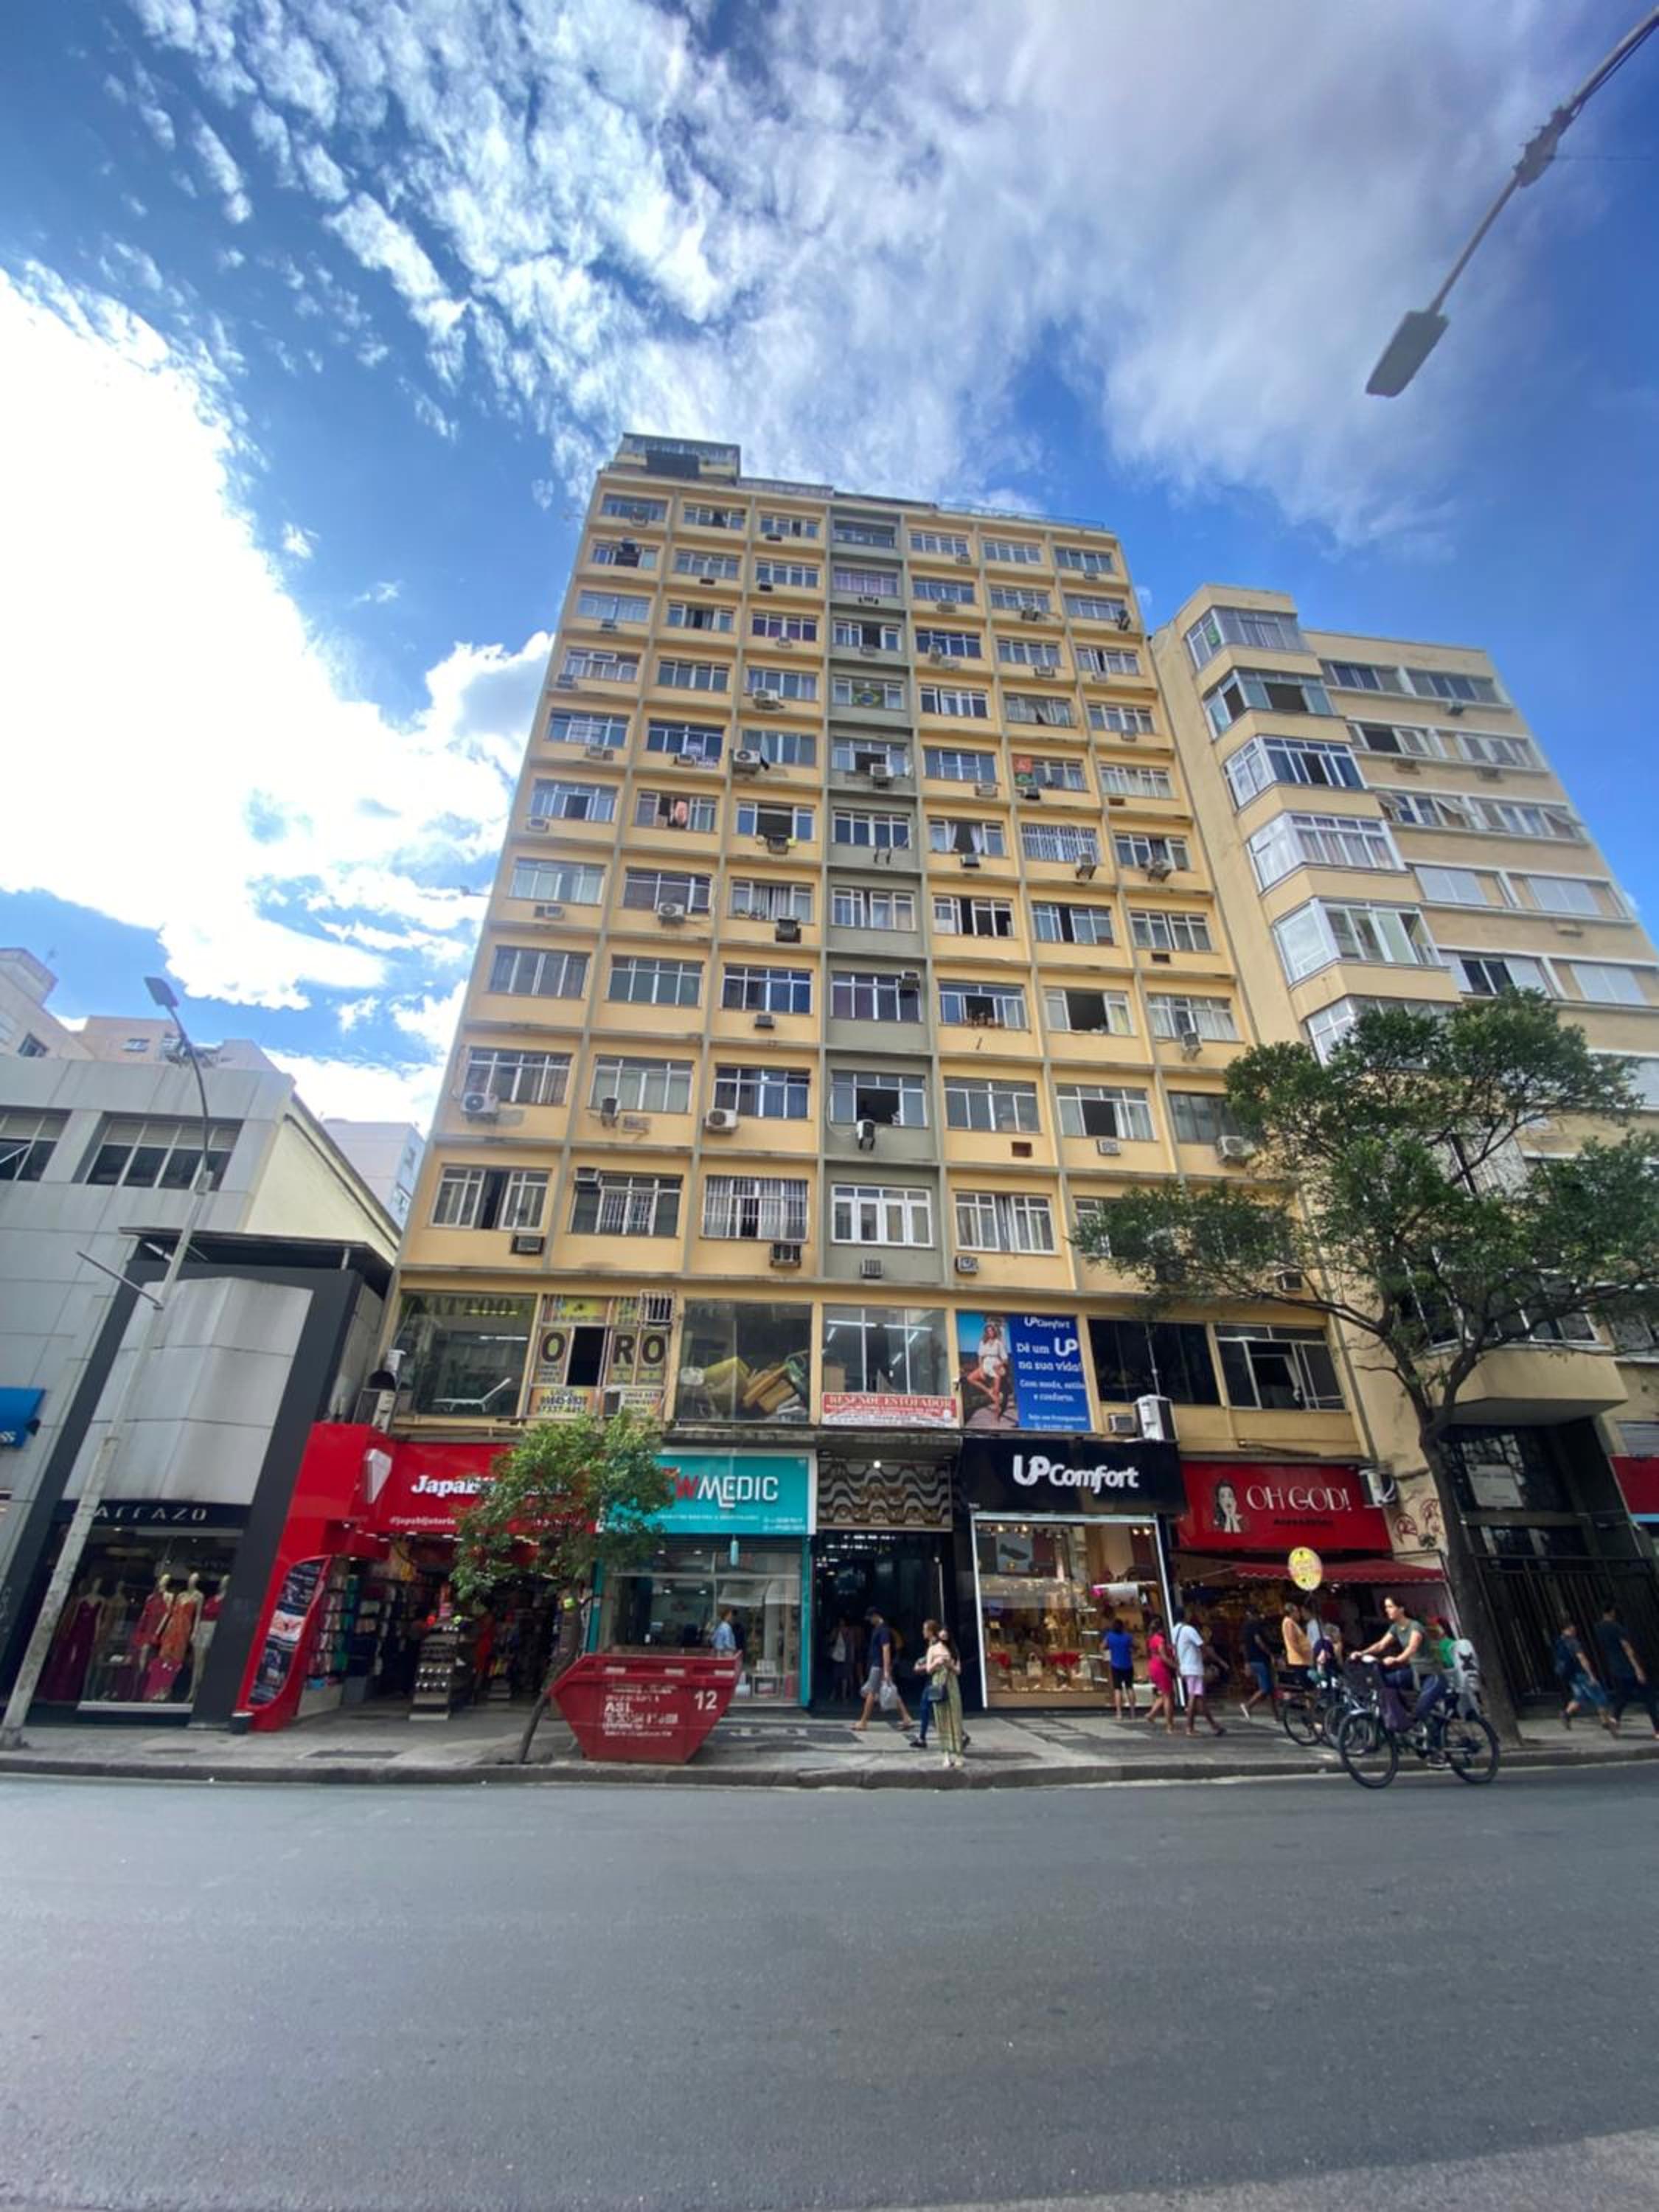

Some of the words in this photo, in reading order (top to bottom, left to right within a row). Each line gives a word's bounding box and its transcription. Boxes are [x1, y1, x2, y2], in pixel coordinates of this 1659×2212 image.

[1054, 1337, 1078, 1357] UP
[1018, 1361, 1032, 1370] na
[1034, 1362, 1054, 1371] sua
[1246, 1485, 1285, 1510] OH
[695, 1690, 717, 1711] 12
